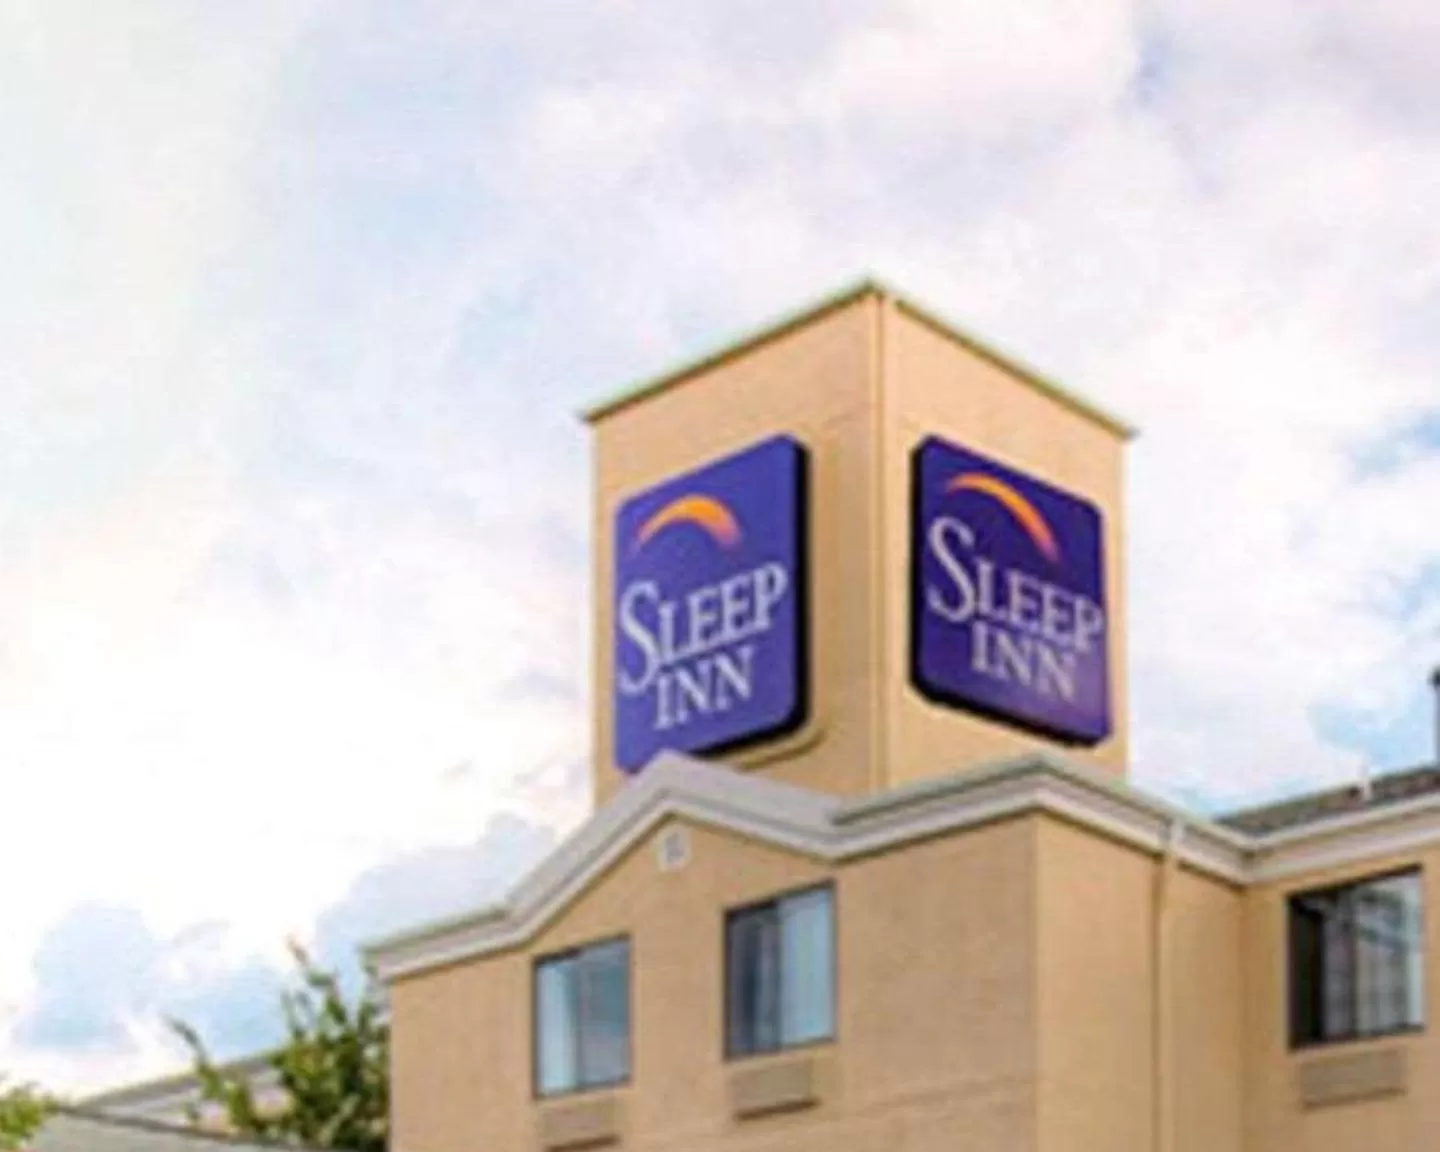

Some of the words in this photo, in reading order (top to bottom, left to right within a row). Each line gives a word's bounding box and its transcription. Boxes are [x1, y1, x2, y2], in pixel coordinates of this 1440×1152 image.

[619, 561, 789, 696] SLEEP
[926, 515, 1105, 654] SLEEP
[654, 644, 755, 730] INN
[971, 620, 1077, 699] INN
